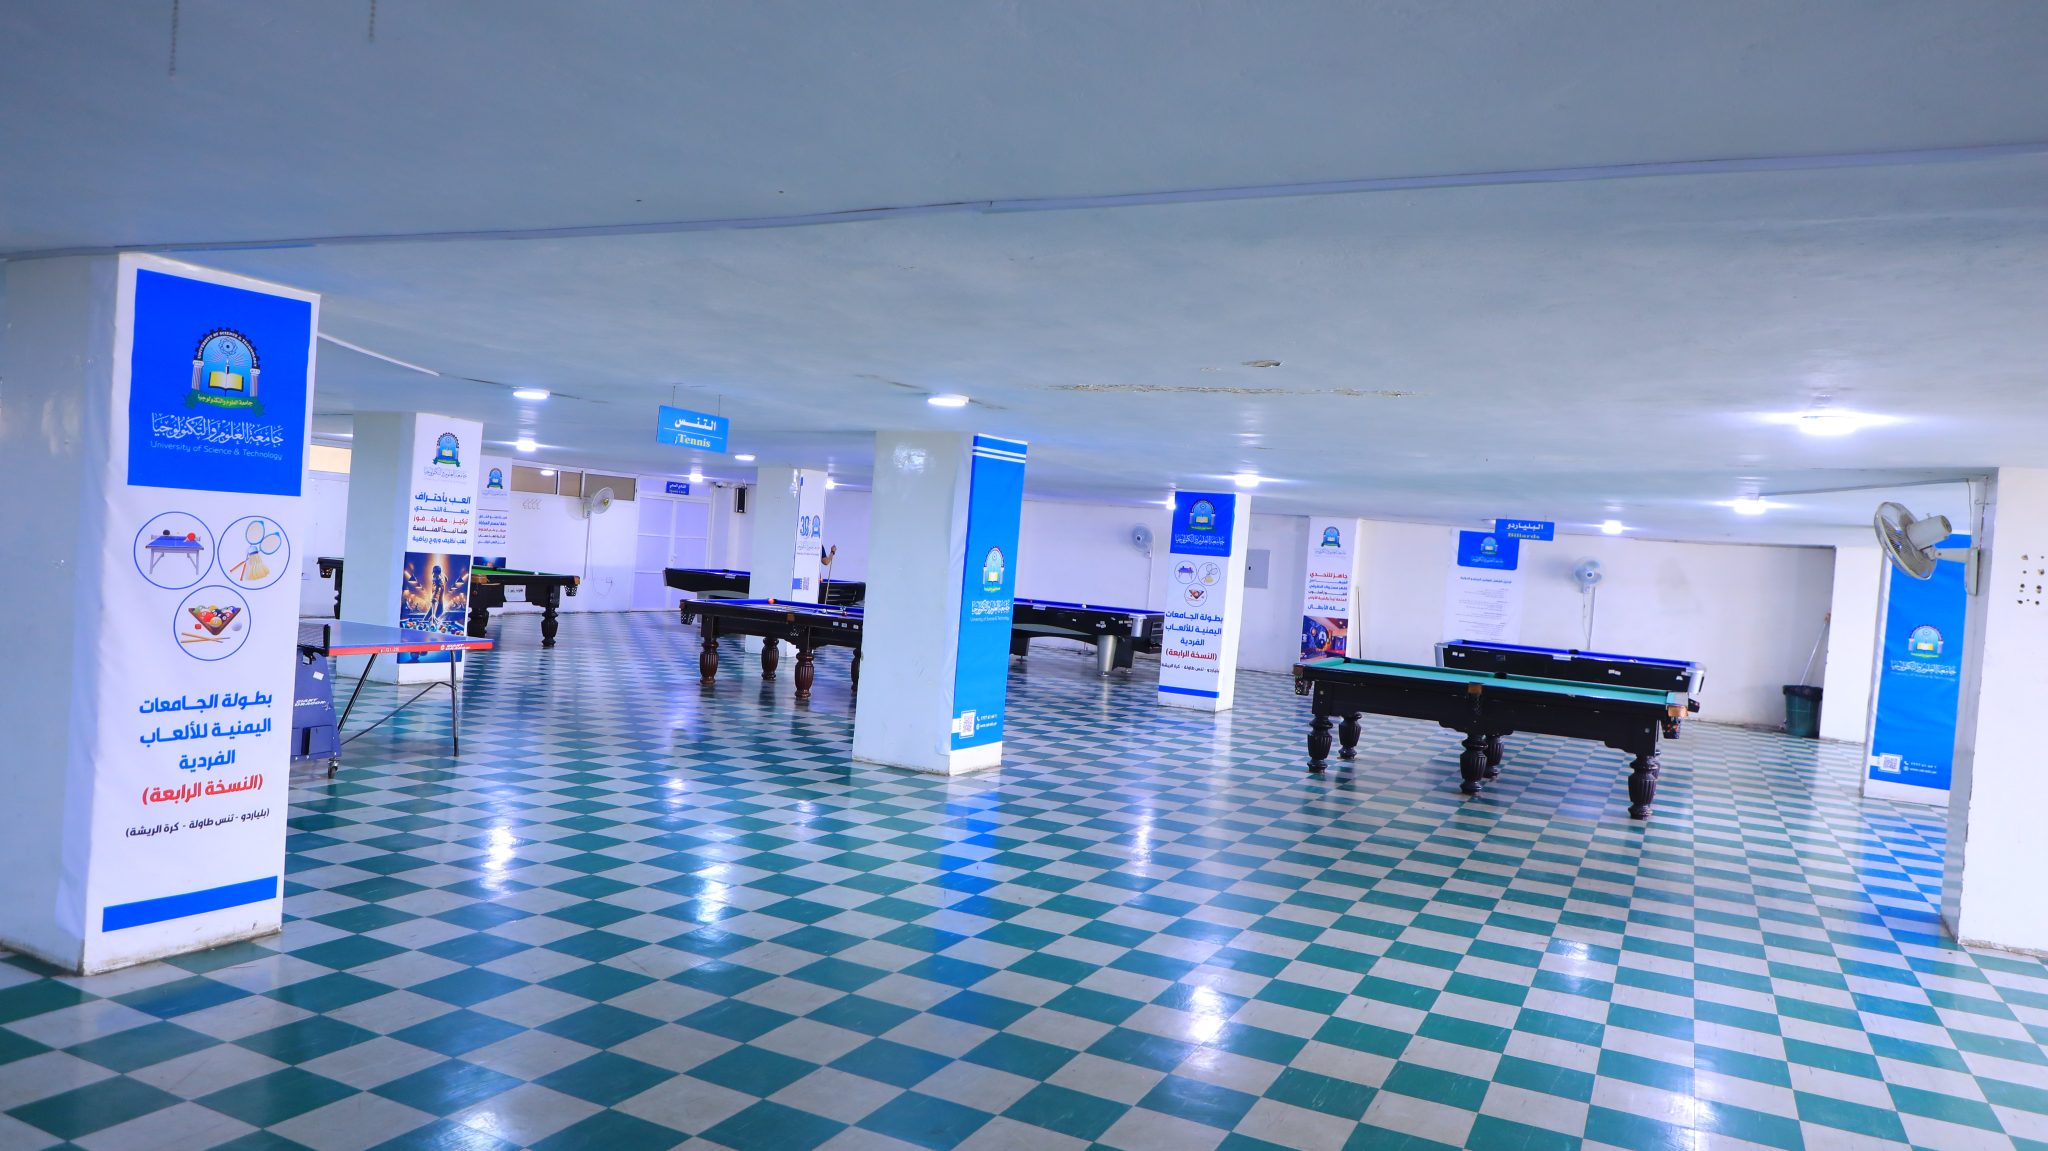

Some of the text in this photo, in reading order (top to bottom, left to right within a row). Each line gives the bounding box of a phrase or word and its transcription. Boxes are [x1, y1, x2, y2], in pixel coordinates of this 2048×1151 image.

[674, 417, 717, 431] التنس
[150, 440, 191, 452] University
[204, 446, 232, 455] Science
[242, 449, 282, 460] Technology
[1166, 611, 1198, 621] الجامعات
[1195, 626, 1222, 636] اليمنية
[1180, 637, 1205, 646] الفردية
[139, 691, 272, 713] بطولة الجامعات
[140, 718, 271, 748] اليمنية للألعاب
[179, 749, 236, 773] الفردية
[142, 774, 263, 805] (النسخة الرابعة)
[215, 814, 234, 826] تنس
[240, 808, 270, 823] (بلياردو
[164, 823, 179, 834] كرة
[189, 818, 213, 829] طاولة
[125, 825, 162, 837] الريشة)
